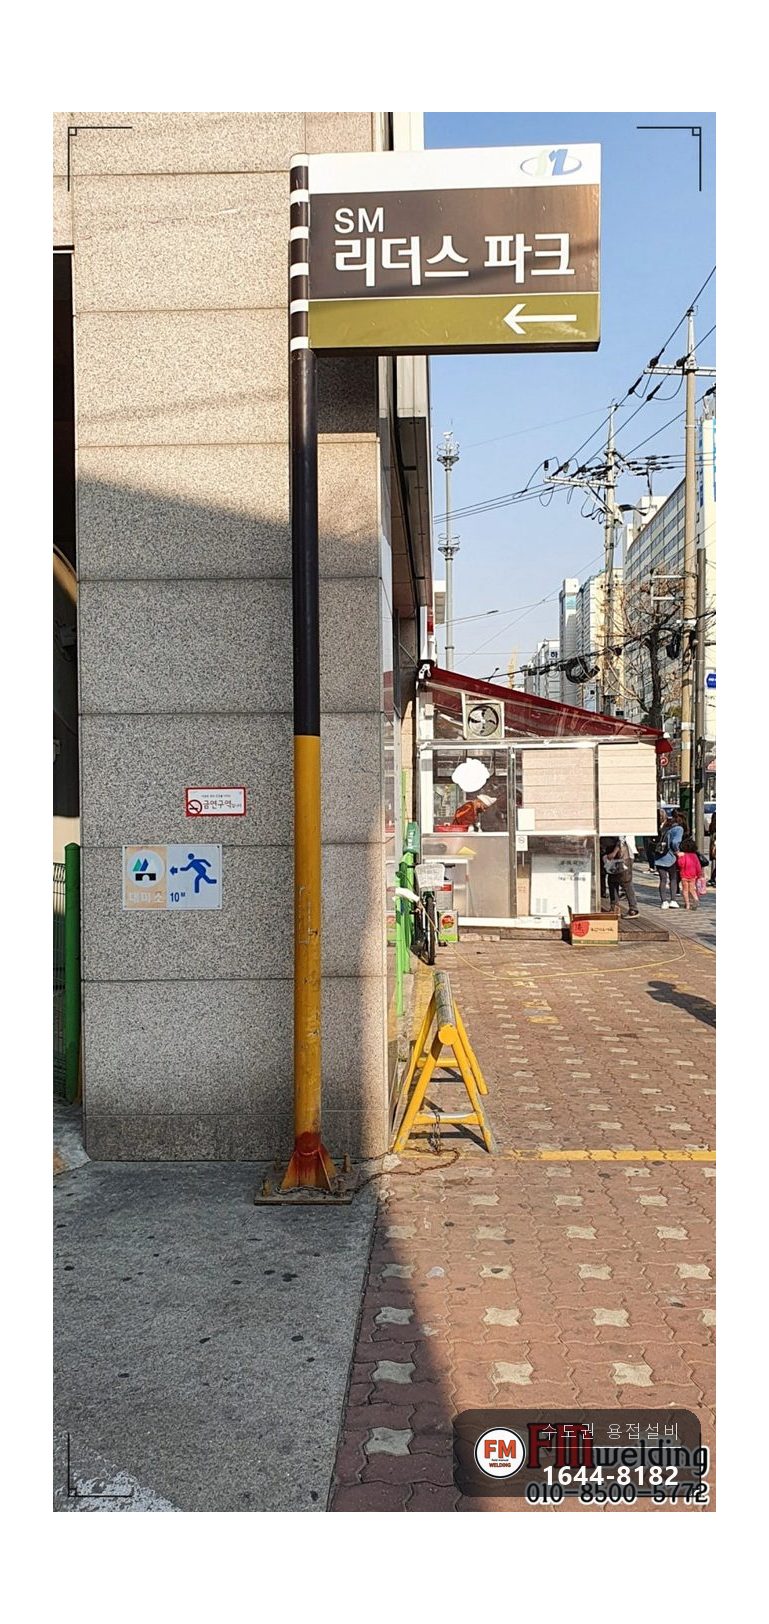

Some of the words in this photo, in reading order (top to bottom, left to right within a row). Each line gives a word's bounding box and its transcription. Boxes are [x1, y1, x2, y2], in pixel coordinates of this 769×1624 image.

[333, 207, 385, 234] SM
[333, 235, 470, 287] 리더스
[483, 232, 576, 284] 파크
